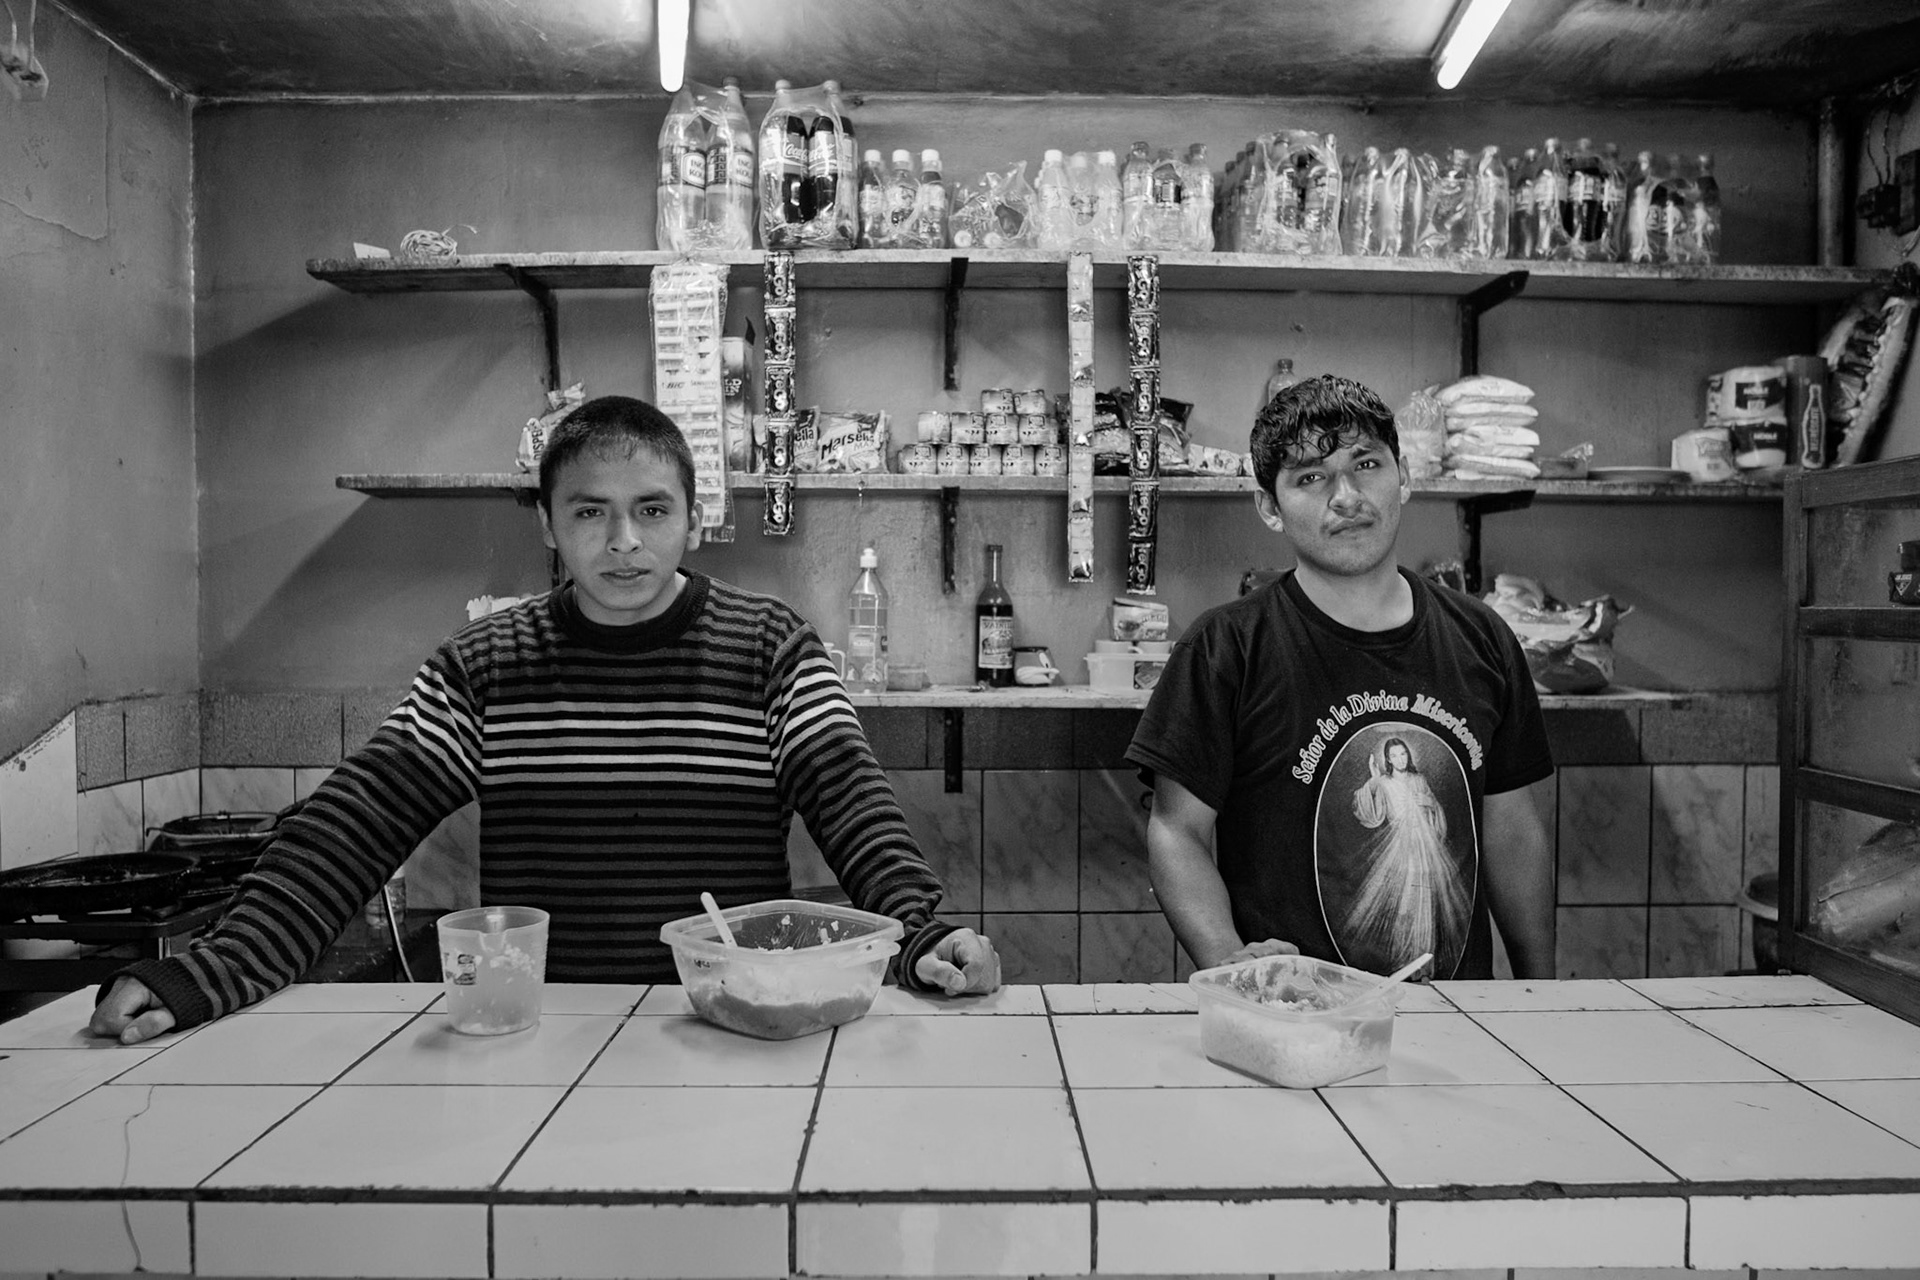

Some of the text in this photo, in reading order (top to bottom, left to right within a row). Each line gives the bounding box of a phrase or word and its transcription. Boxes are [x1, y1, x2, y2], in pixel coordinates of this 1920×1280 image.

[1292, 734, 1327, 785] Señor
[1316, 718, 1339, 741] de
[1329, 705, 1352, 726] la
[1347, 689, 1409, 718] Divina
